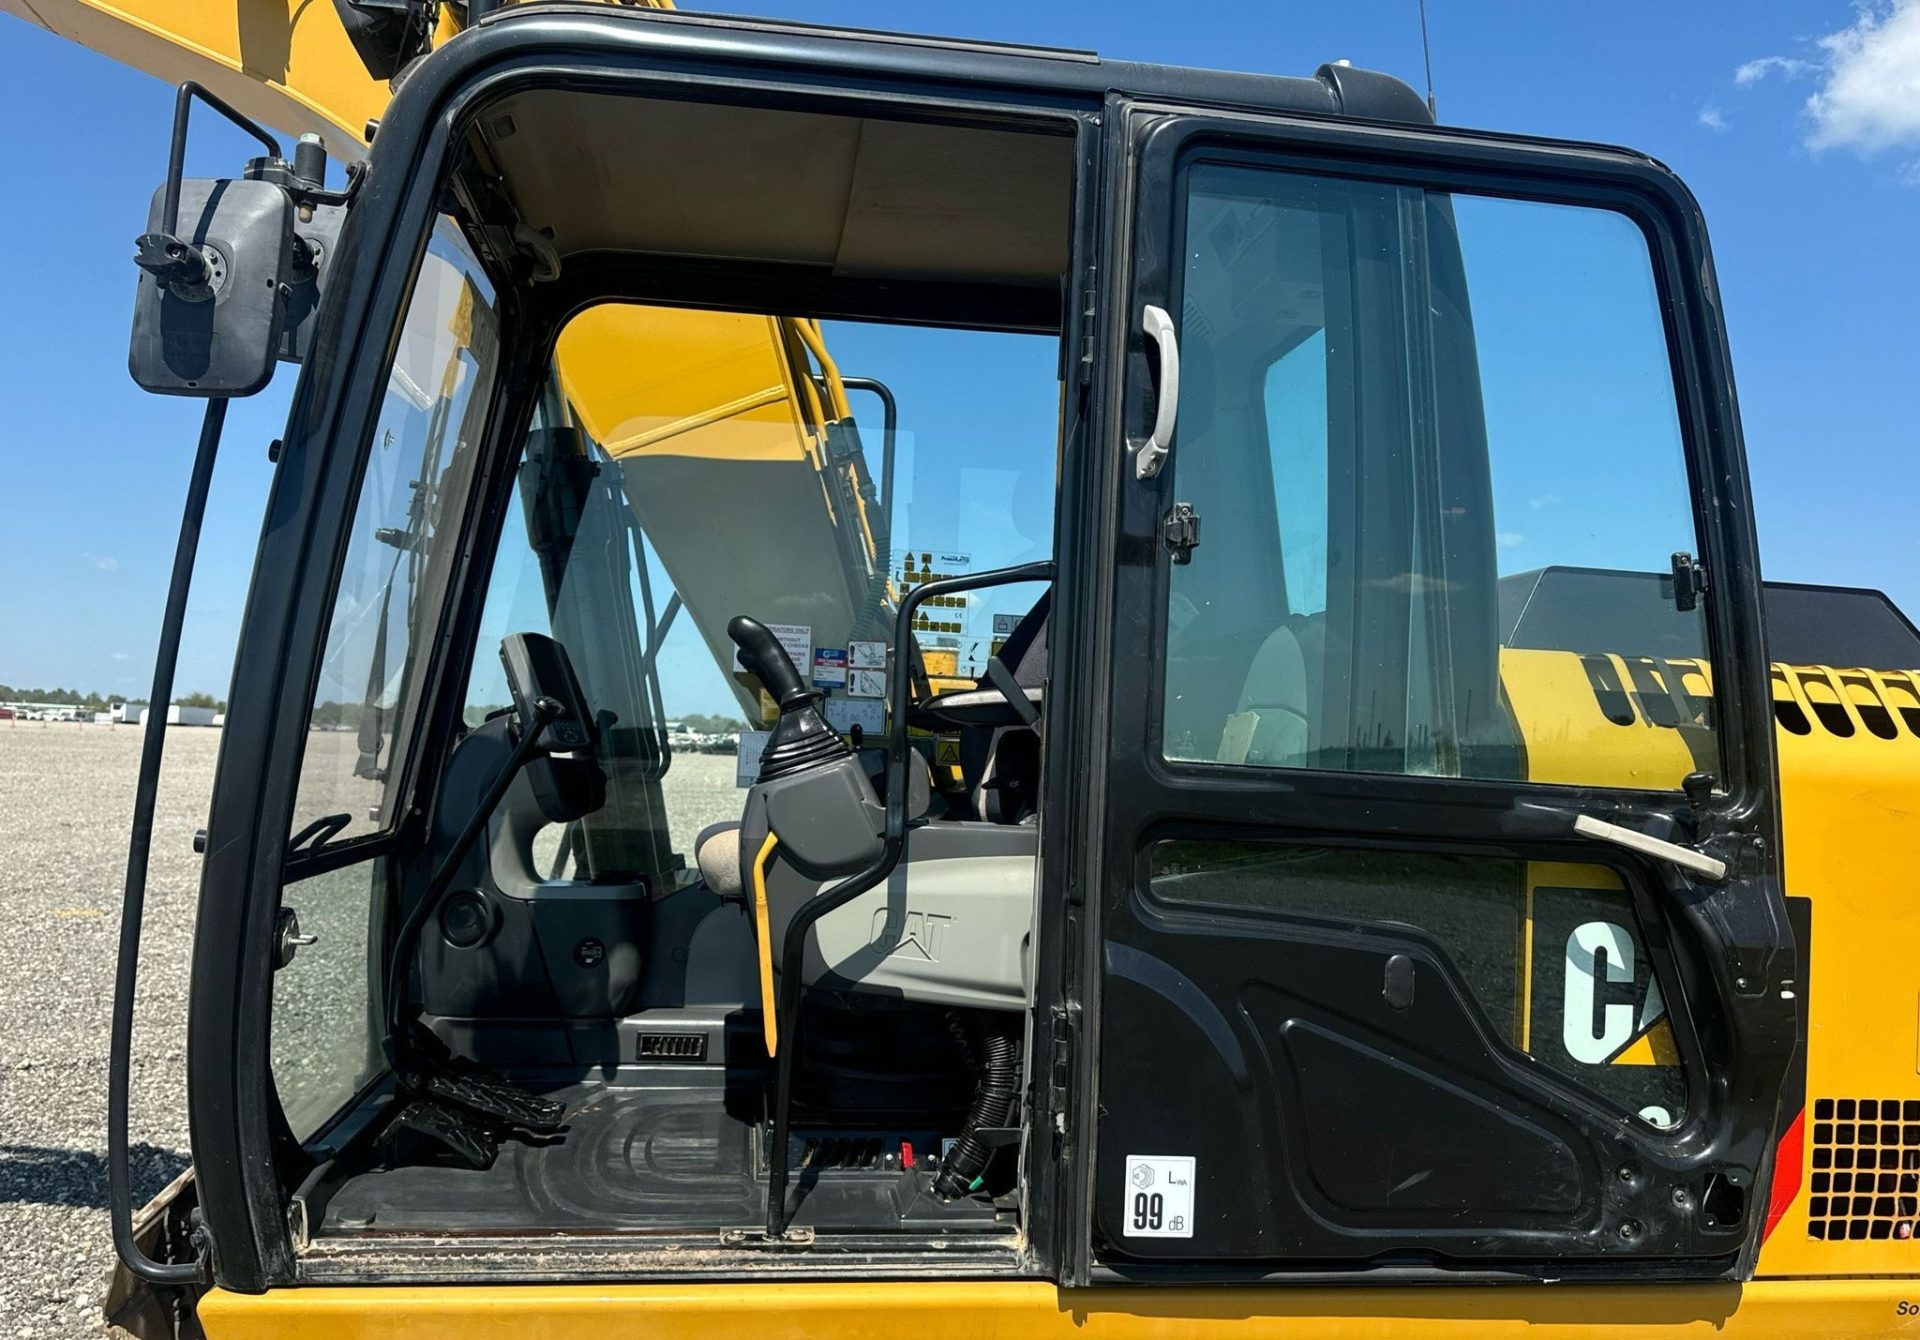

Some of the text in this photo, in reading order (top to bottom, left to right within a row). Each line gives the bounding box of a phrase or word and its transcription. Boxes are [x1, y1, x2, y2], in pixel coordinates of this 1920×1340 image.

[870, 907, 952, 963] CAT
[1133, 1192, 1184, 1231] 99 dB
[1896, 1300, 1920, 1316] So
